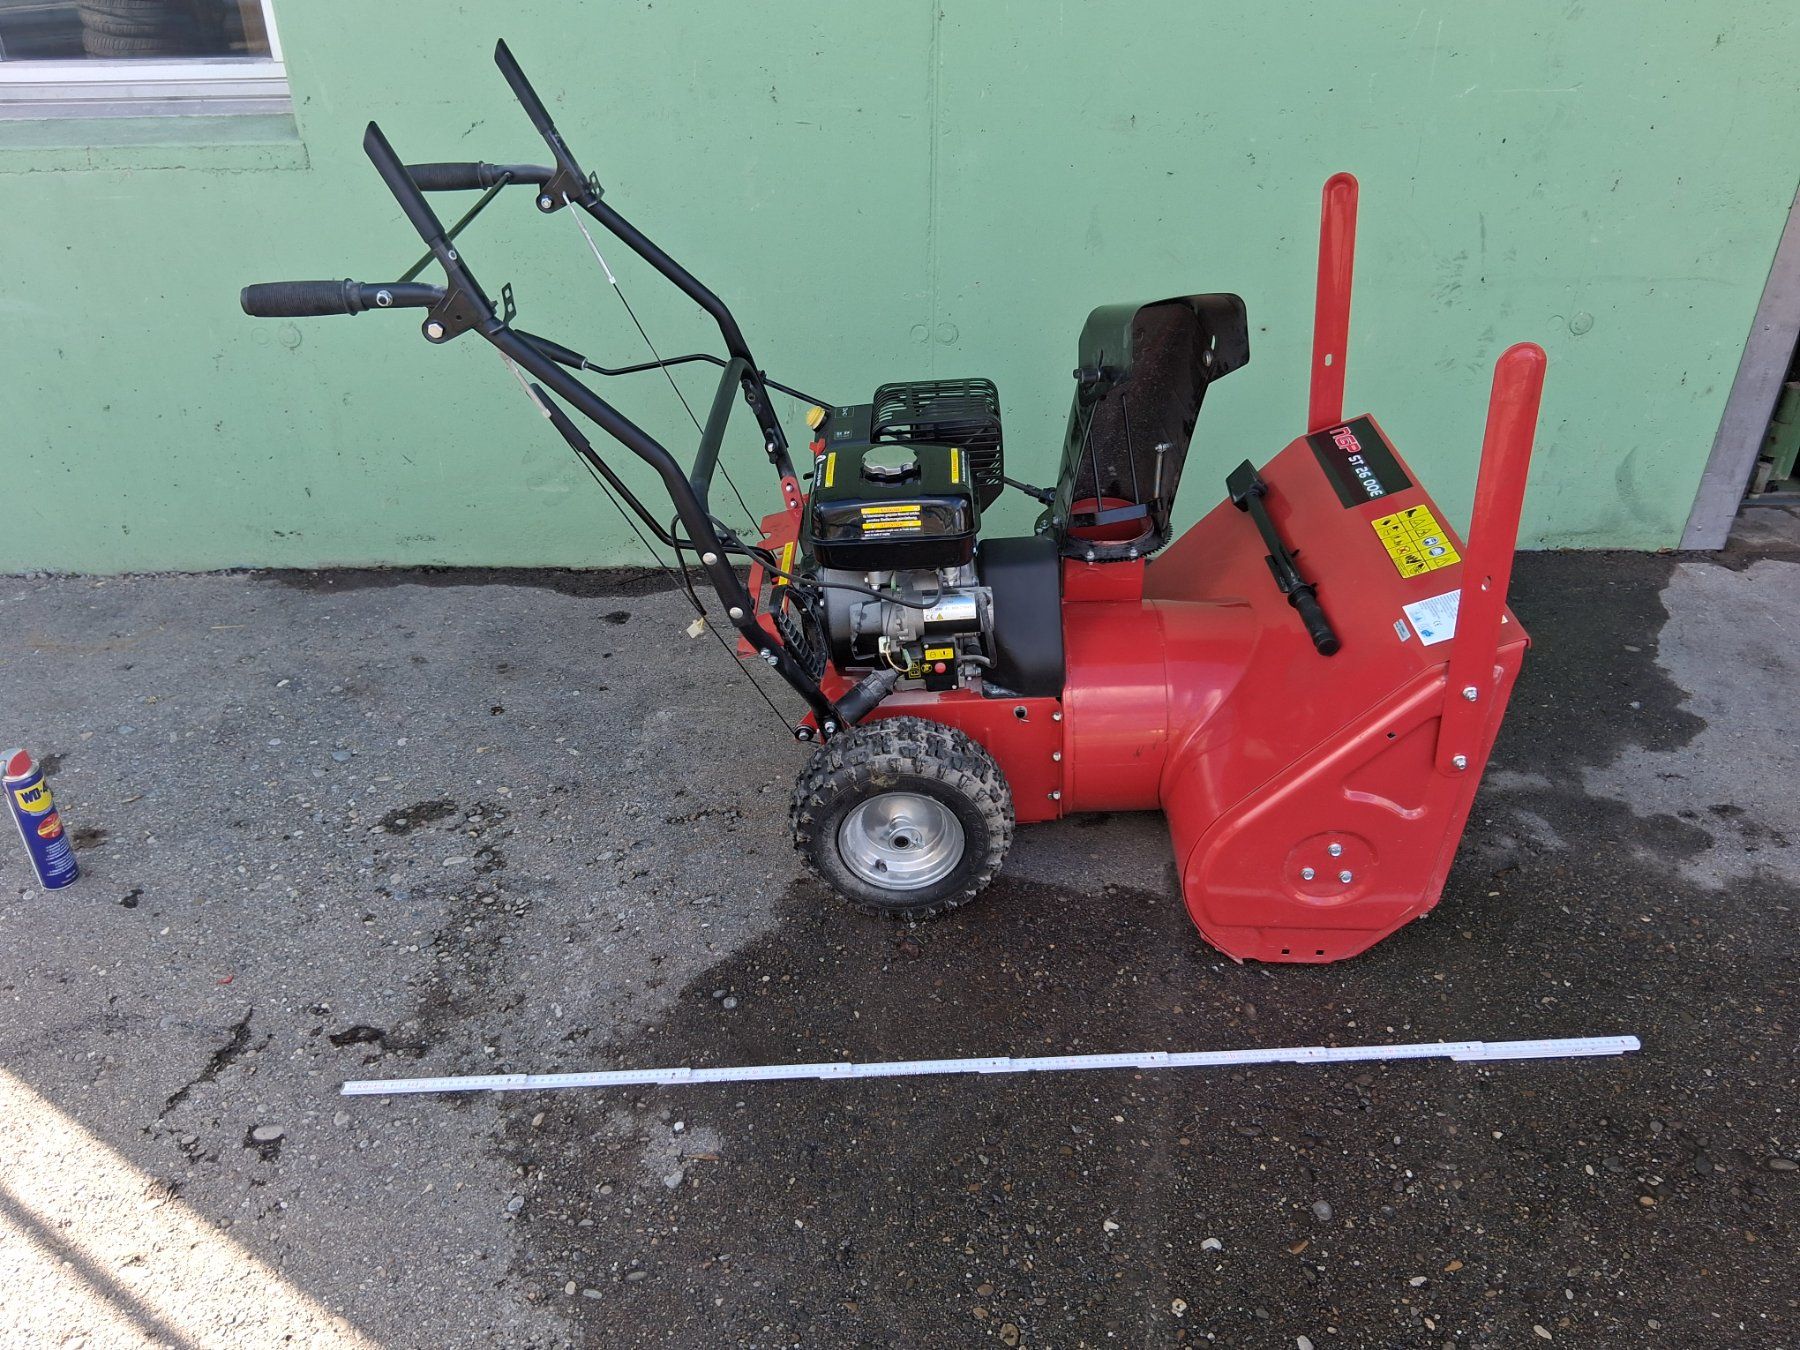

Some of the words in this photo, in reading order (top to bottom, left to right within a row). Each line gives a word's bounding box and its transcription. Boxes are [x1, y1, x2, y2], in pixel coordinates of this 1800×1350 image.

[1347, 454, 1364, 466] ST
[1354, 466, 1372, 479] 26
[20, 780, 47, 804] WD-4
